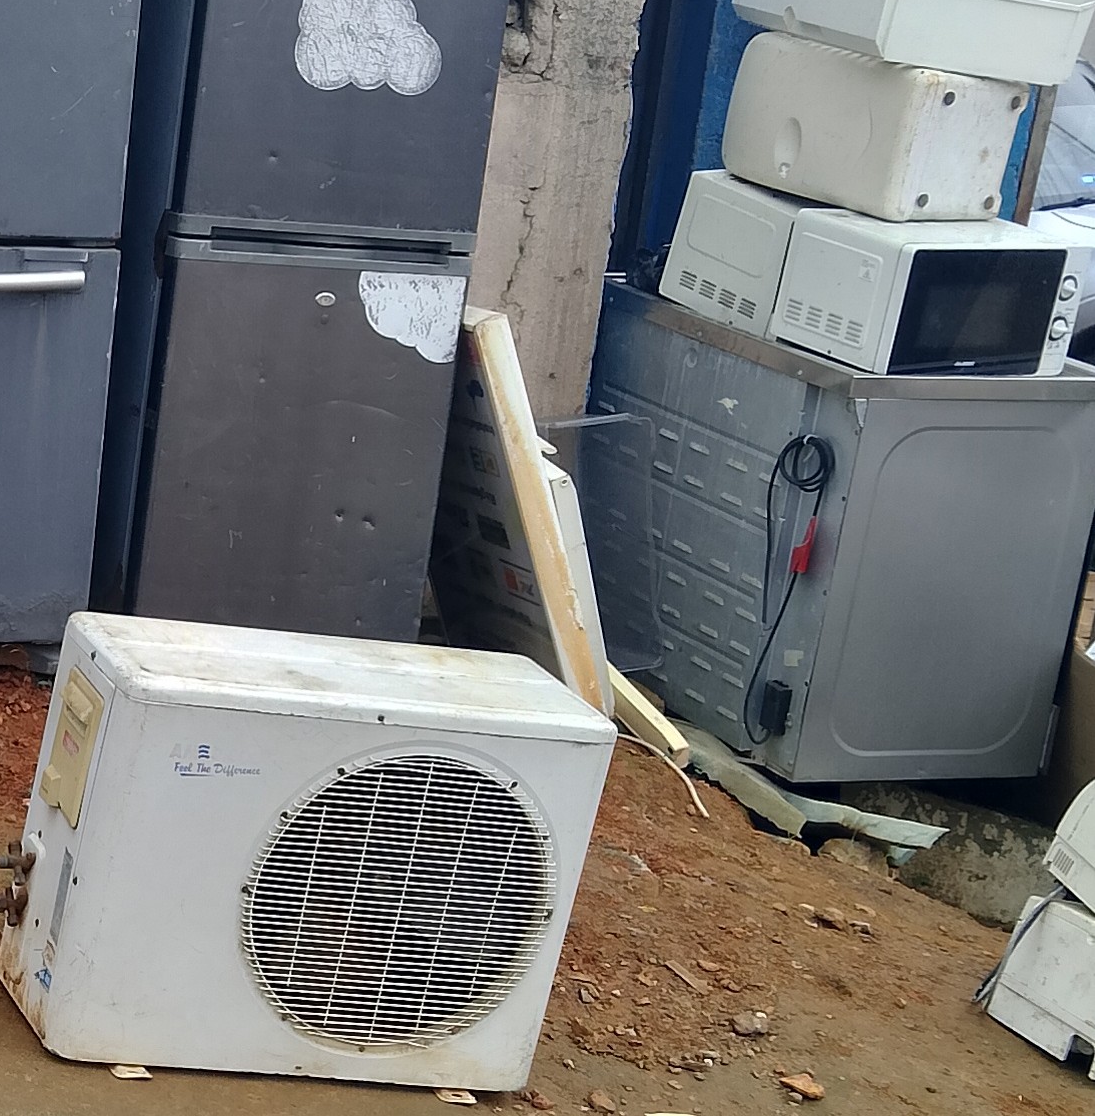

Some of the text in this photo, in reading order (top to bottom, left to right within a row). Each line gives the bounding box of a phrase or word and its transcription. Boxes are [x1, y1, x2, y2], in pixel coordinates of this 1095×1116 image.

[174, 762, 261, 777] Feel The Difference
